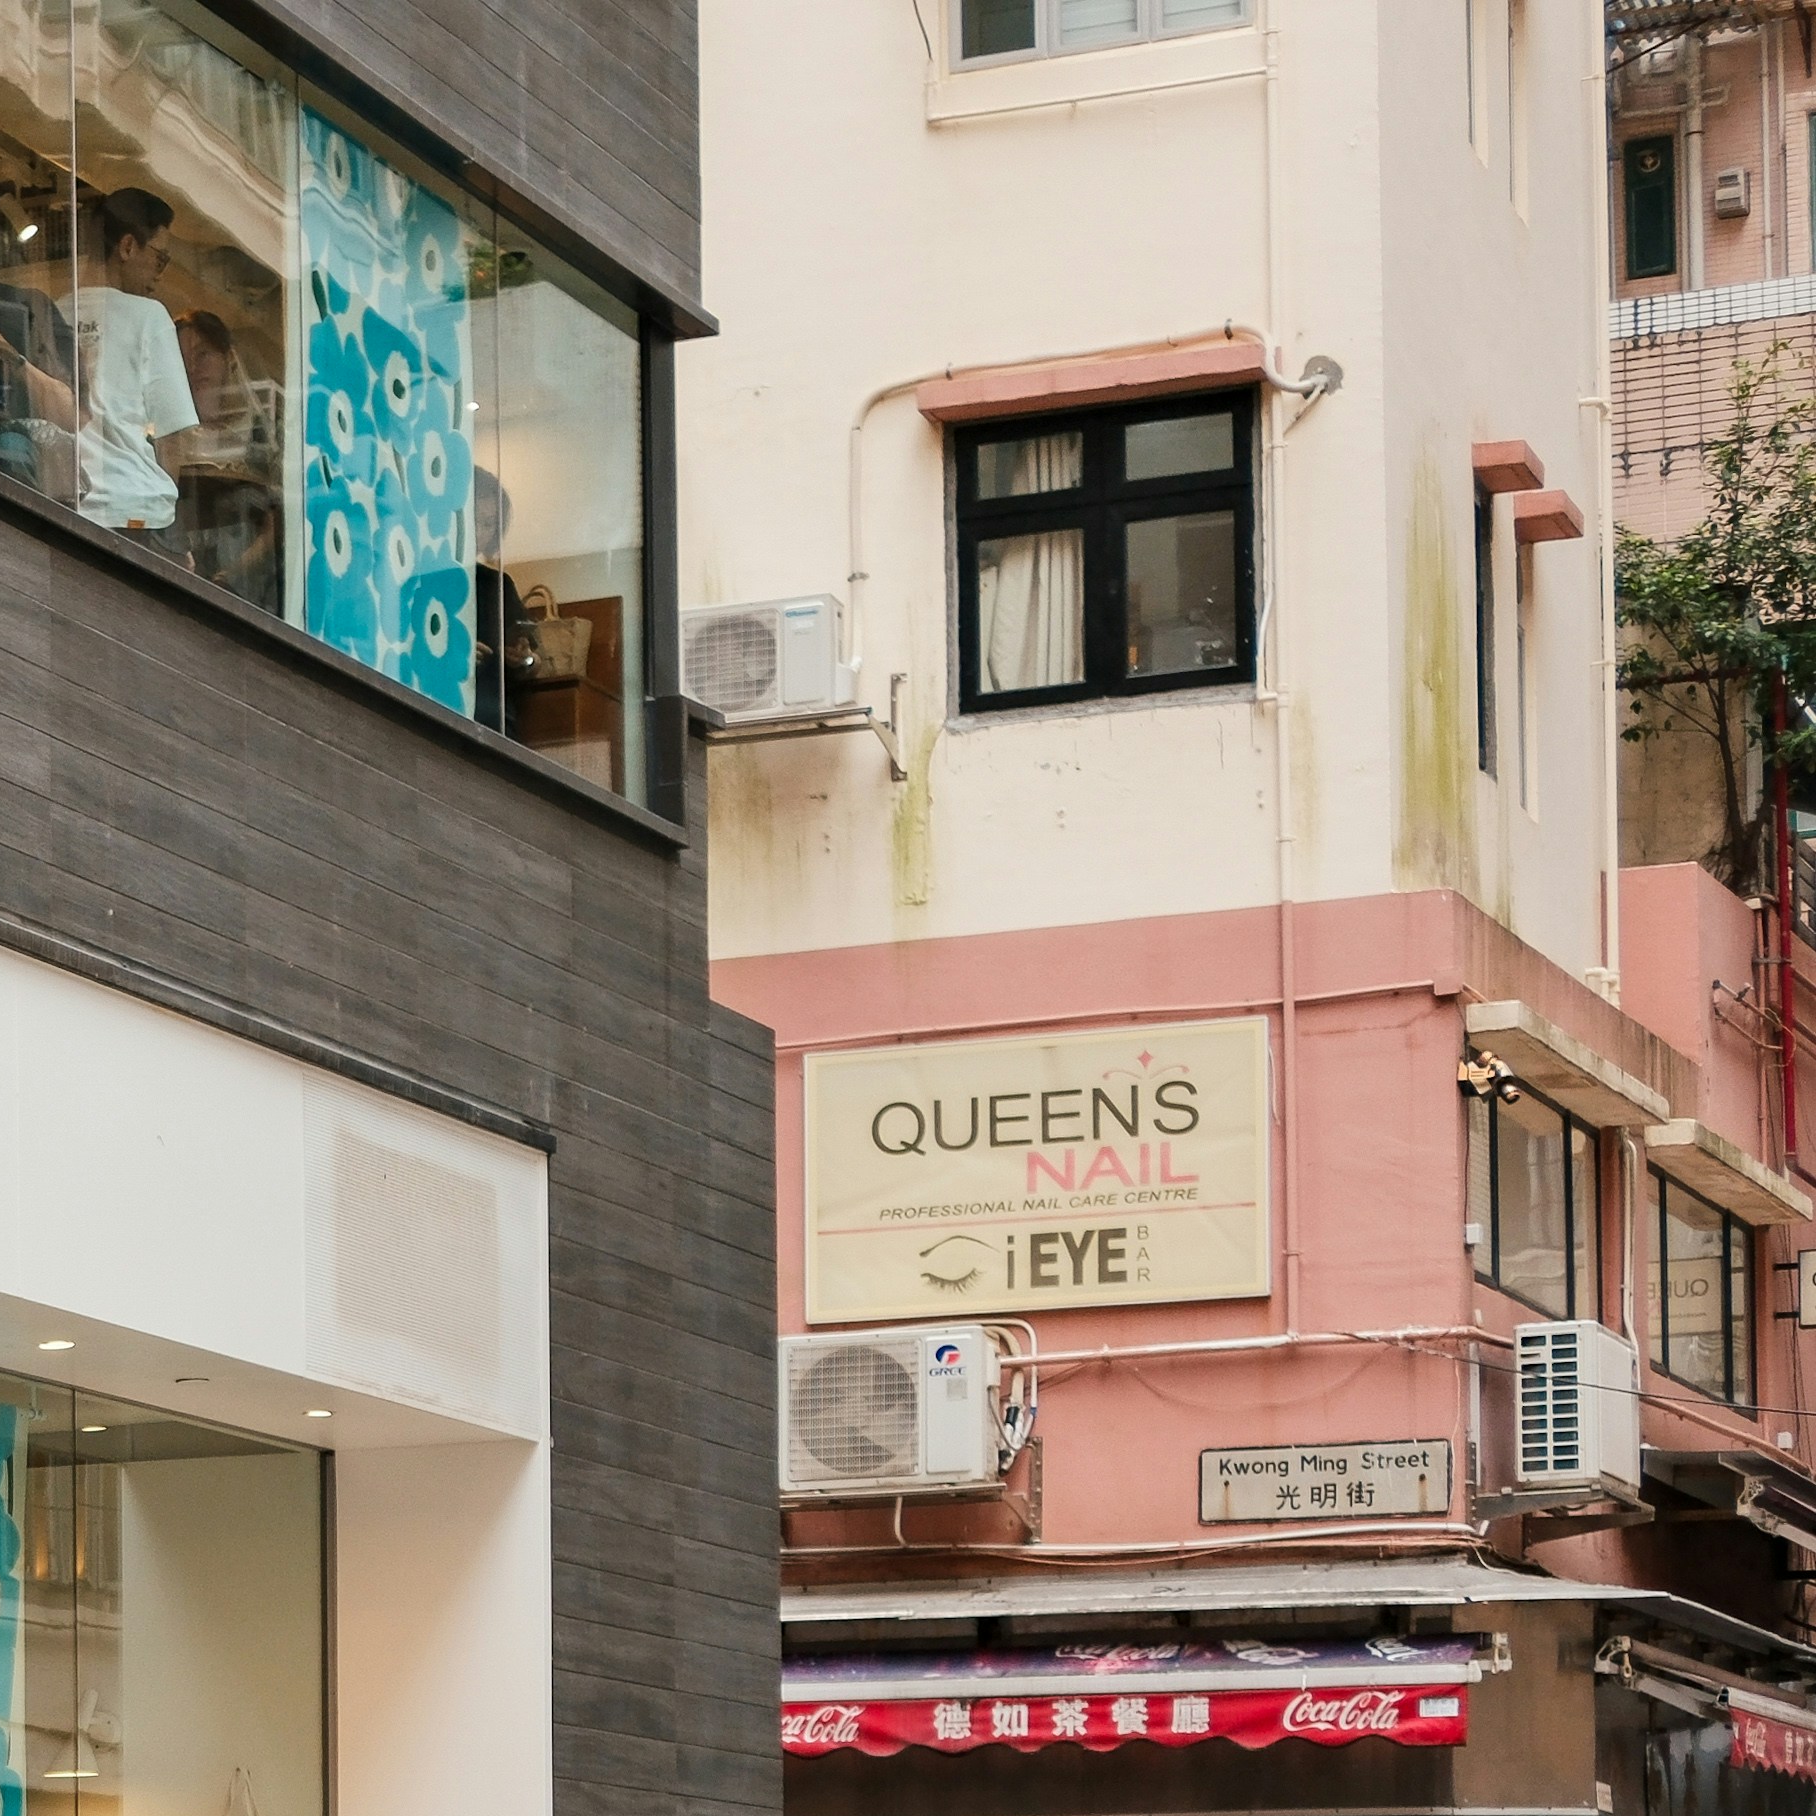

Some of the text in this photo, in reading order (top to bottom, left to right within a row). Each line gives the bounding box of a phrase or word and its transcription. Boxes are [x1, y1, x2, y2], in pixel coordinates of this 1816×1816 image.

[871, 1080, 1201, 1157] QUEENS
[1025, 1142, 1201, 1194] NAIL
[879, 1187, 1200, 1221] PROFESSIONAL NAIL CARE CENTRE
[1135, 1224, 1152, 1284] BAR
[1218, 1450, 1430, 1478] Kwong Ming Street
[1275, 1480, 1375, 1511] 光明街
[933, 1695, 1211, 1740] 德如茶餐廳
